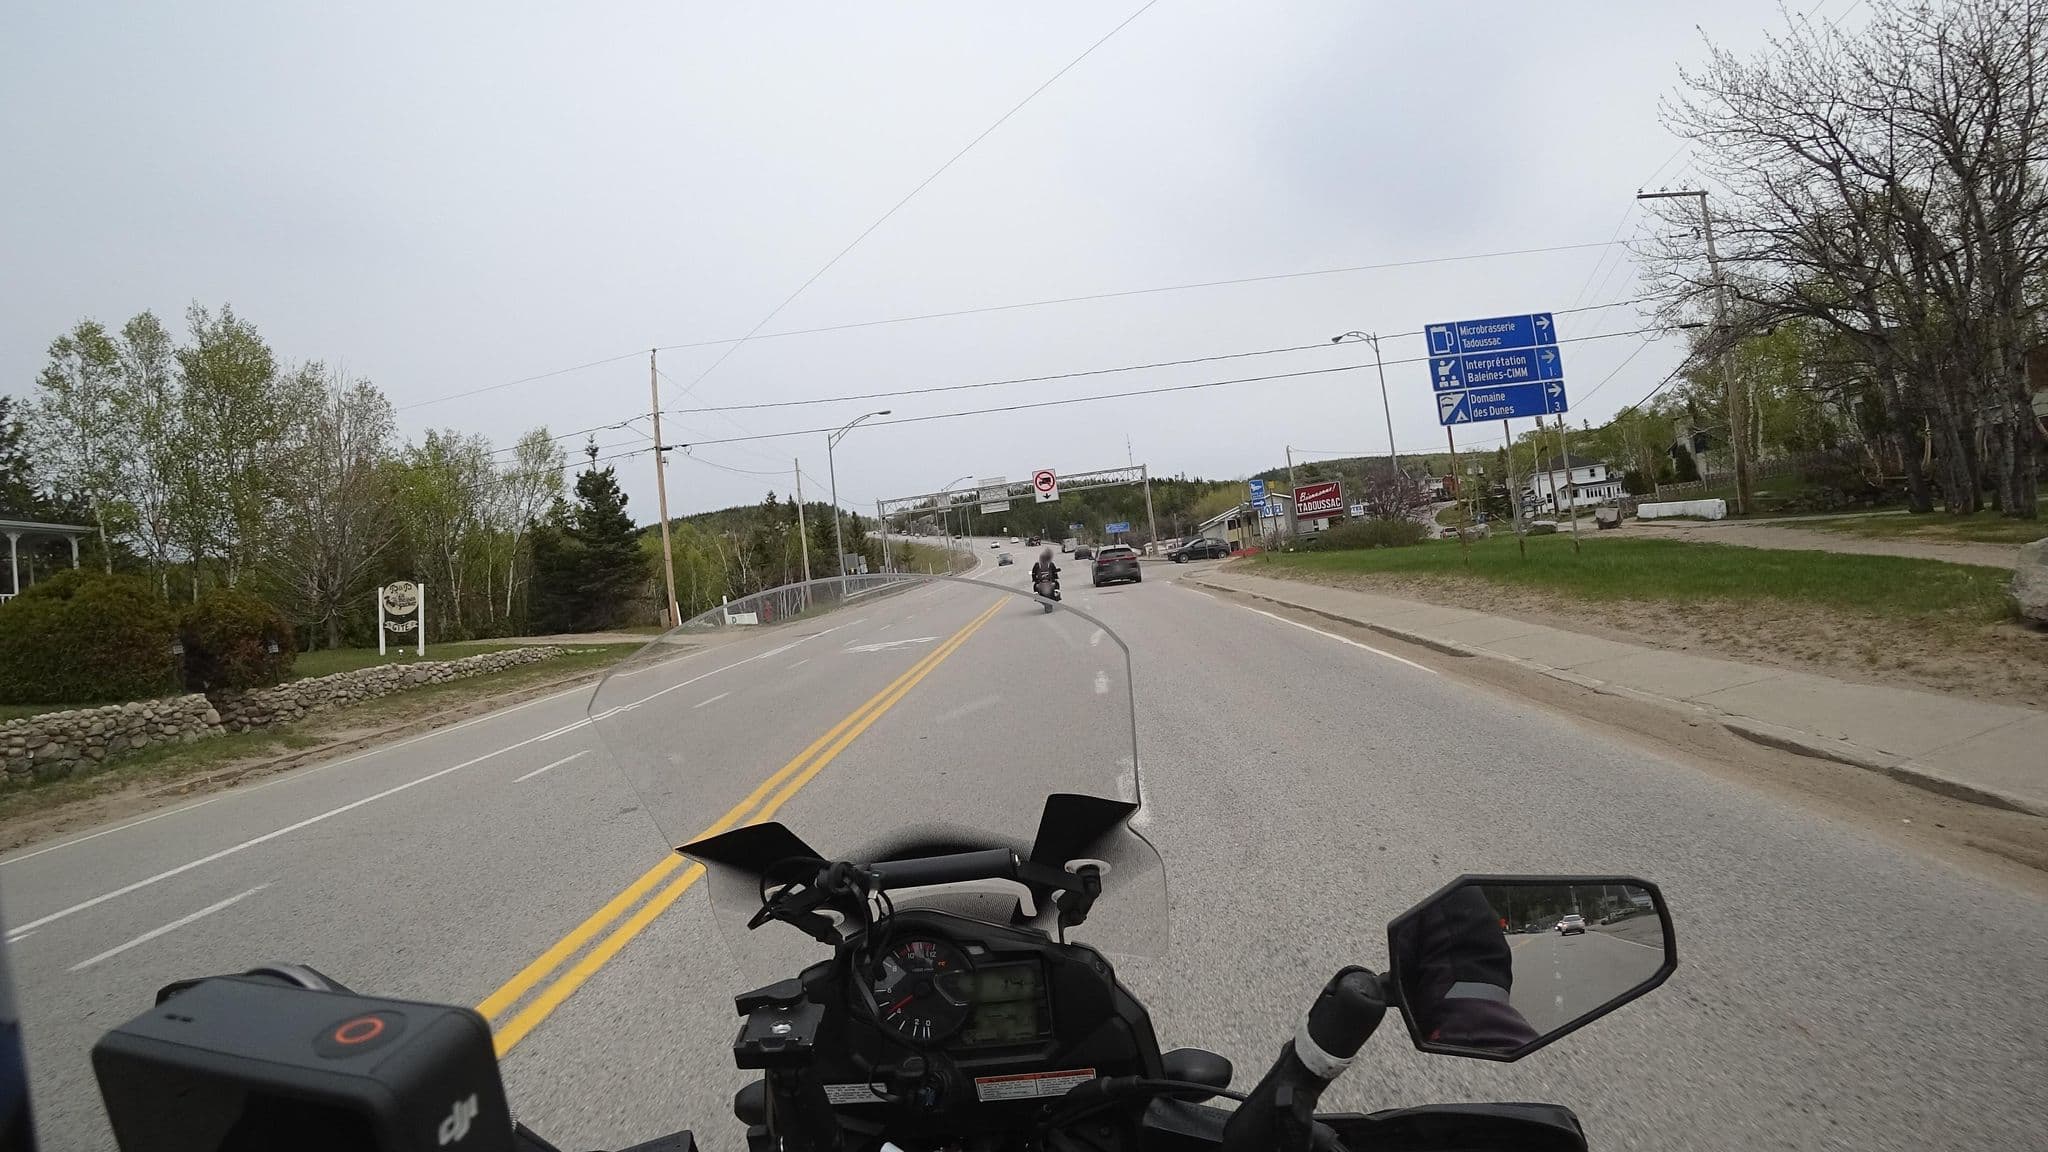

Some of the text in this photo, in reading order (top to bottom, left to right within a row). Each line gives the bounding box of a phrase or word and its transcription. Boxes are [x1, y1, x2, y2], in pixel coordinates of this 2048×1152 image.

[1460, 322, 1515, 335] Microbrasserie
[1462, 337, 1502, 348] Tadoussac
[1465, 355, 1527, 370] Interprétation
[1467, 366, 1529, 383] Baleines-CIMM
[1470, 392, 1506, 404] Domaine
[1473, 405, 1515, 418] des Dunes
[1297, 497, 1341, 513] TADOUSSAC
[438, 1093, 479, 1146] dji
